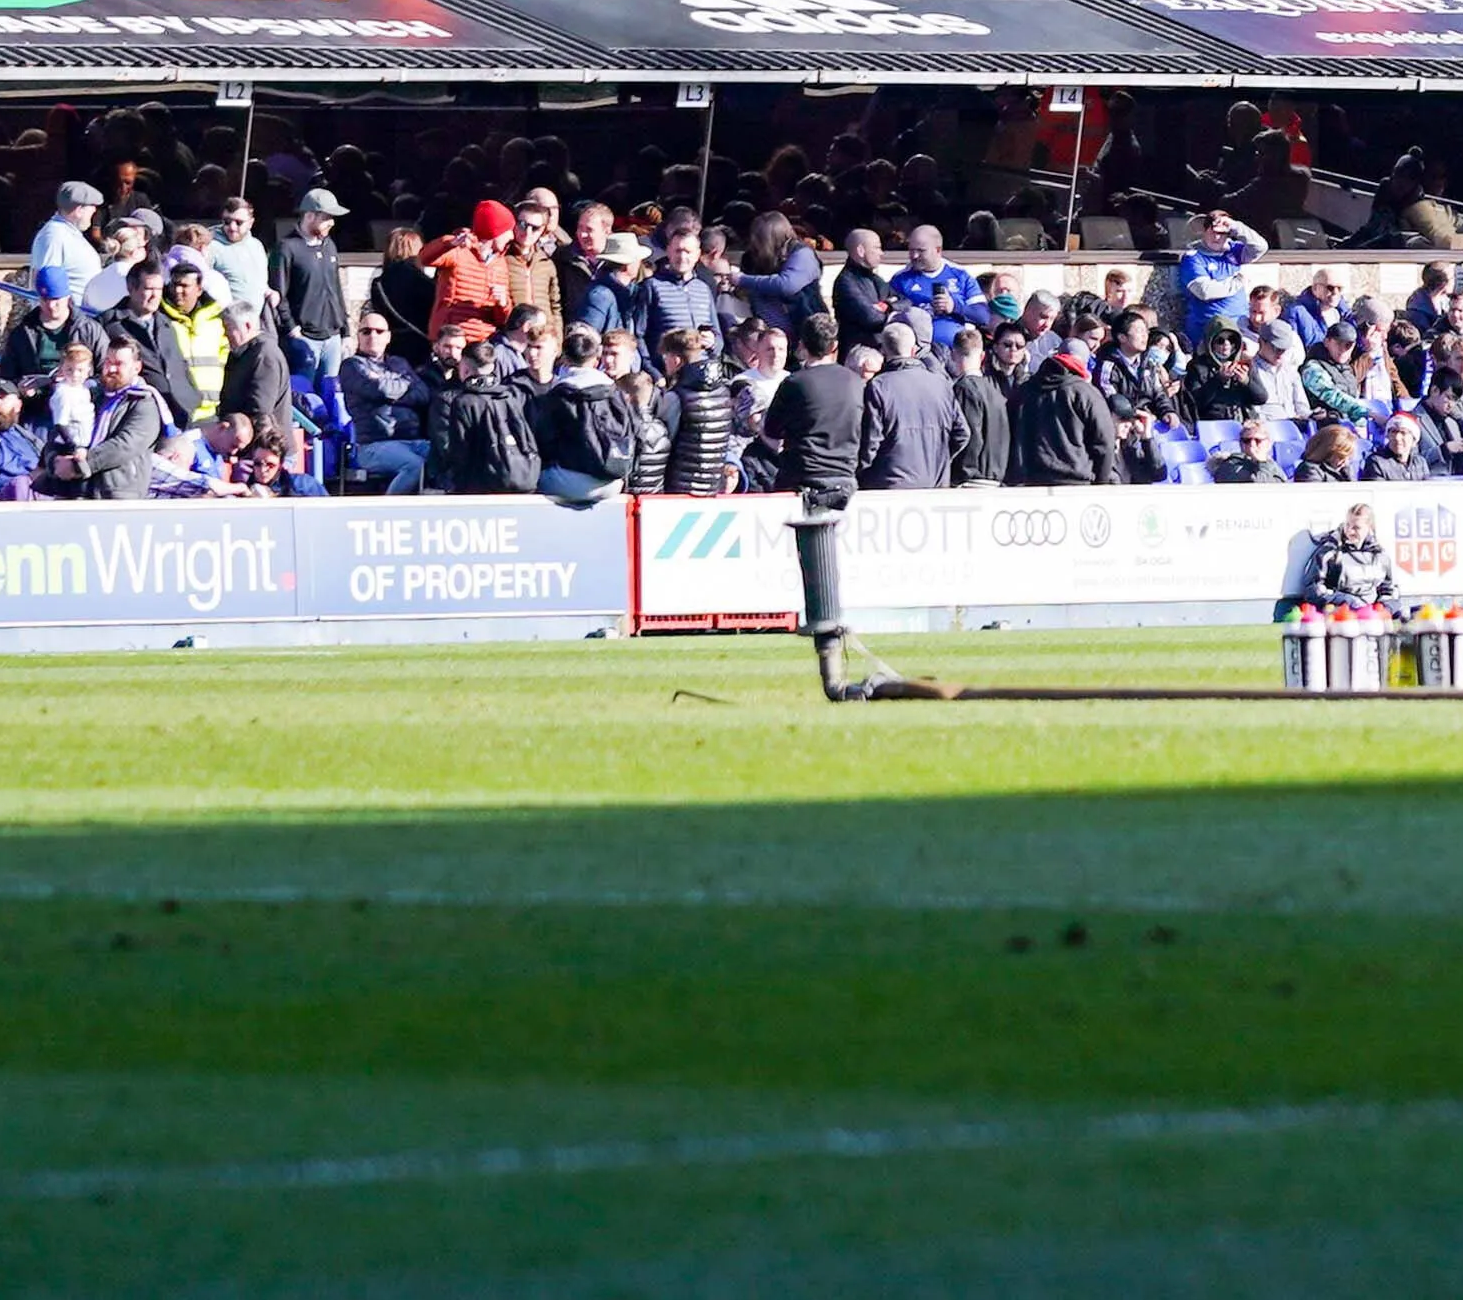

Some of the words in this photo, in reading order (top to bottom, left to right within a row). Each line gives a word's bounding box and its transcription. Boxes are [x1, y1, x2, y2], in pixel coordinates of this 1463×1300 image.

[120, 16, 197, 36] BY
[194, 16, 453, 38] IPSWICH
[690, 10, 991, 36] adidas
[225, 82, 245, 99] L2
[686, 85, 704, 101] L3
[1059, 89, 1078, 104] L4
[755, 504, 981, 557] MRRIOTT
[1396, 509, 1455, 538] SEH
[348, 519, 413, 556] THE
[421, 517, 518, 555] HOME
[1397, 541, 1456, 565] BAC
[350, 564, 395, 602] OF
[404, 562, 577, 600] PROPERTY
